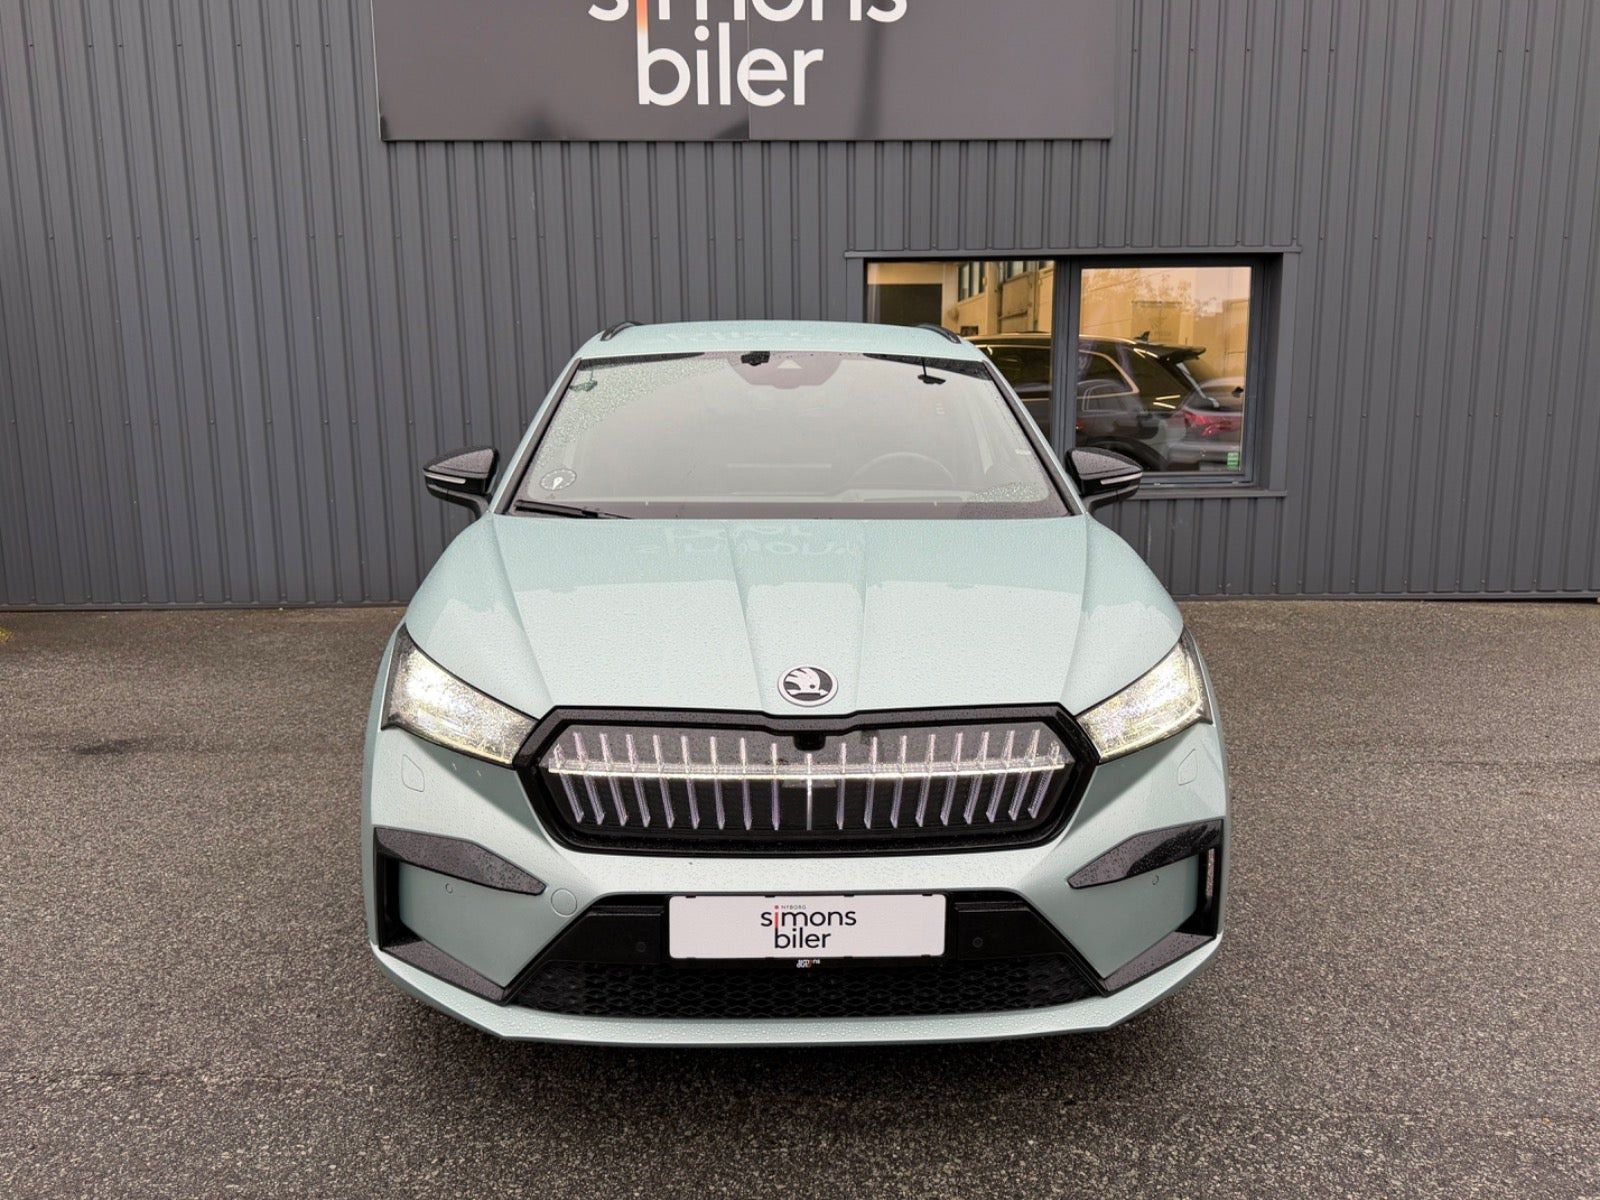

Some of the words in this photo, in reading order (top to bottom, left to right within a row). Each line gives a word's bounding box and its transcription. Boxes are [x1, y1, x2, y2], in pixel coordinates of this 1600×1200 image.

[636, 22, 824, 107] biler
[760, 904, 857, 927] simons
[774, 927, 832, 949] biler
